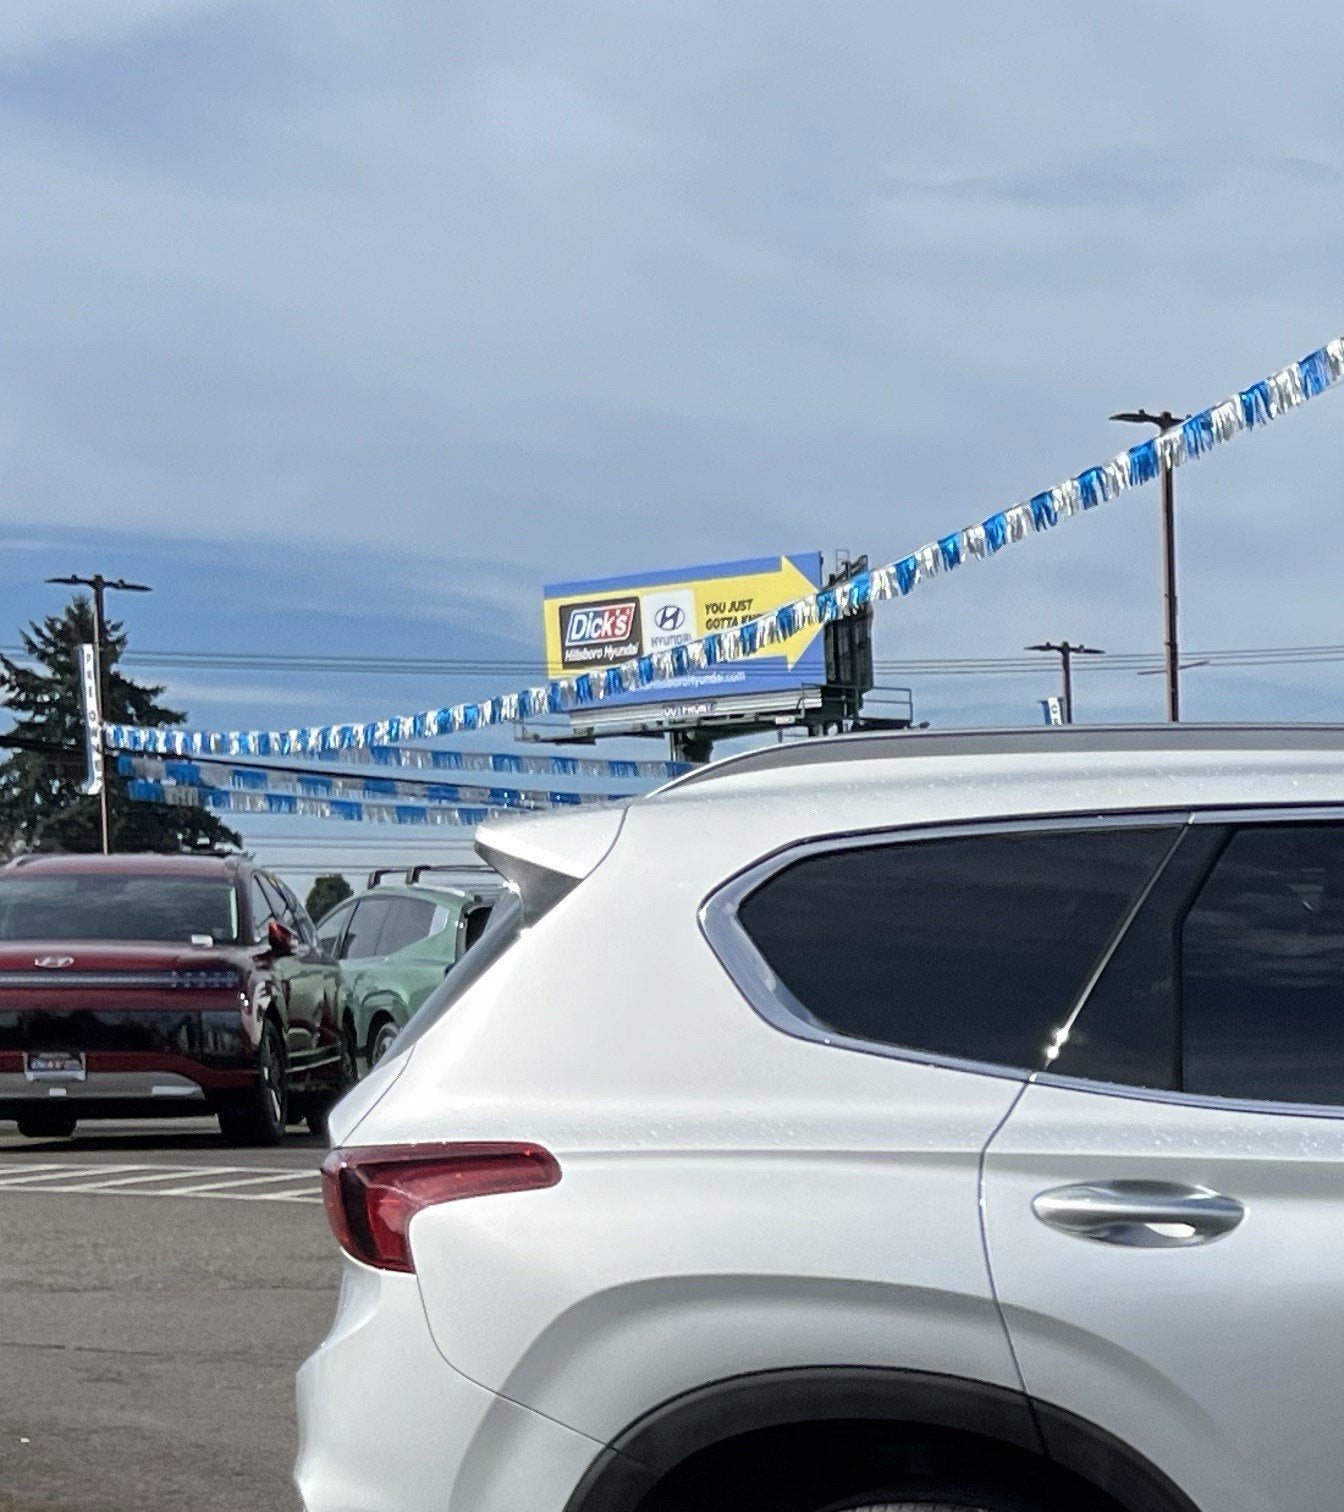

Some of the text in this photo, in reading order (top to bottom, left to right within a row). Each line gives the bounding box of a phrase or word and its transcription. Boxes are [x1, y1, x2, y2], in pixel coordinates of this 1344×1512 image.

[704, 598, 754, 616] YOU JUST
[569, 606, 630, 642] Dick's
[705, 616, 738, 631] GOTTA
